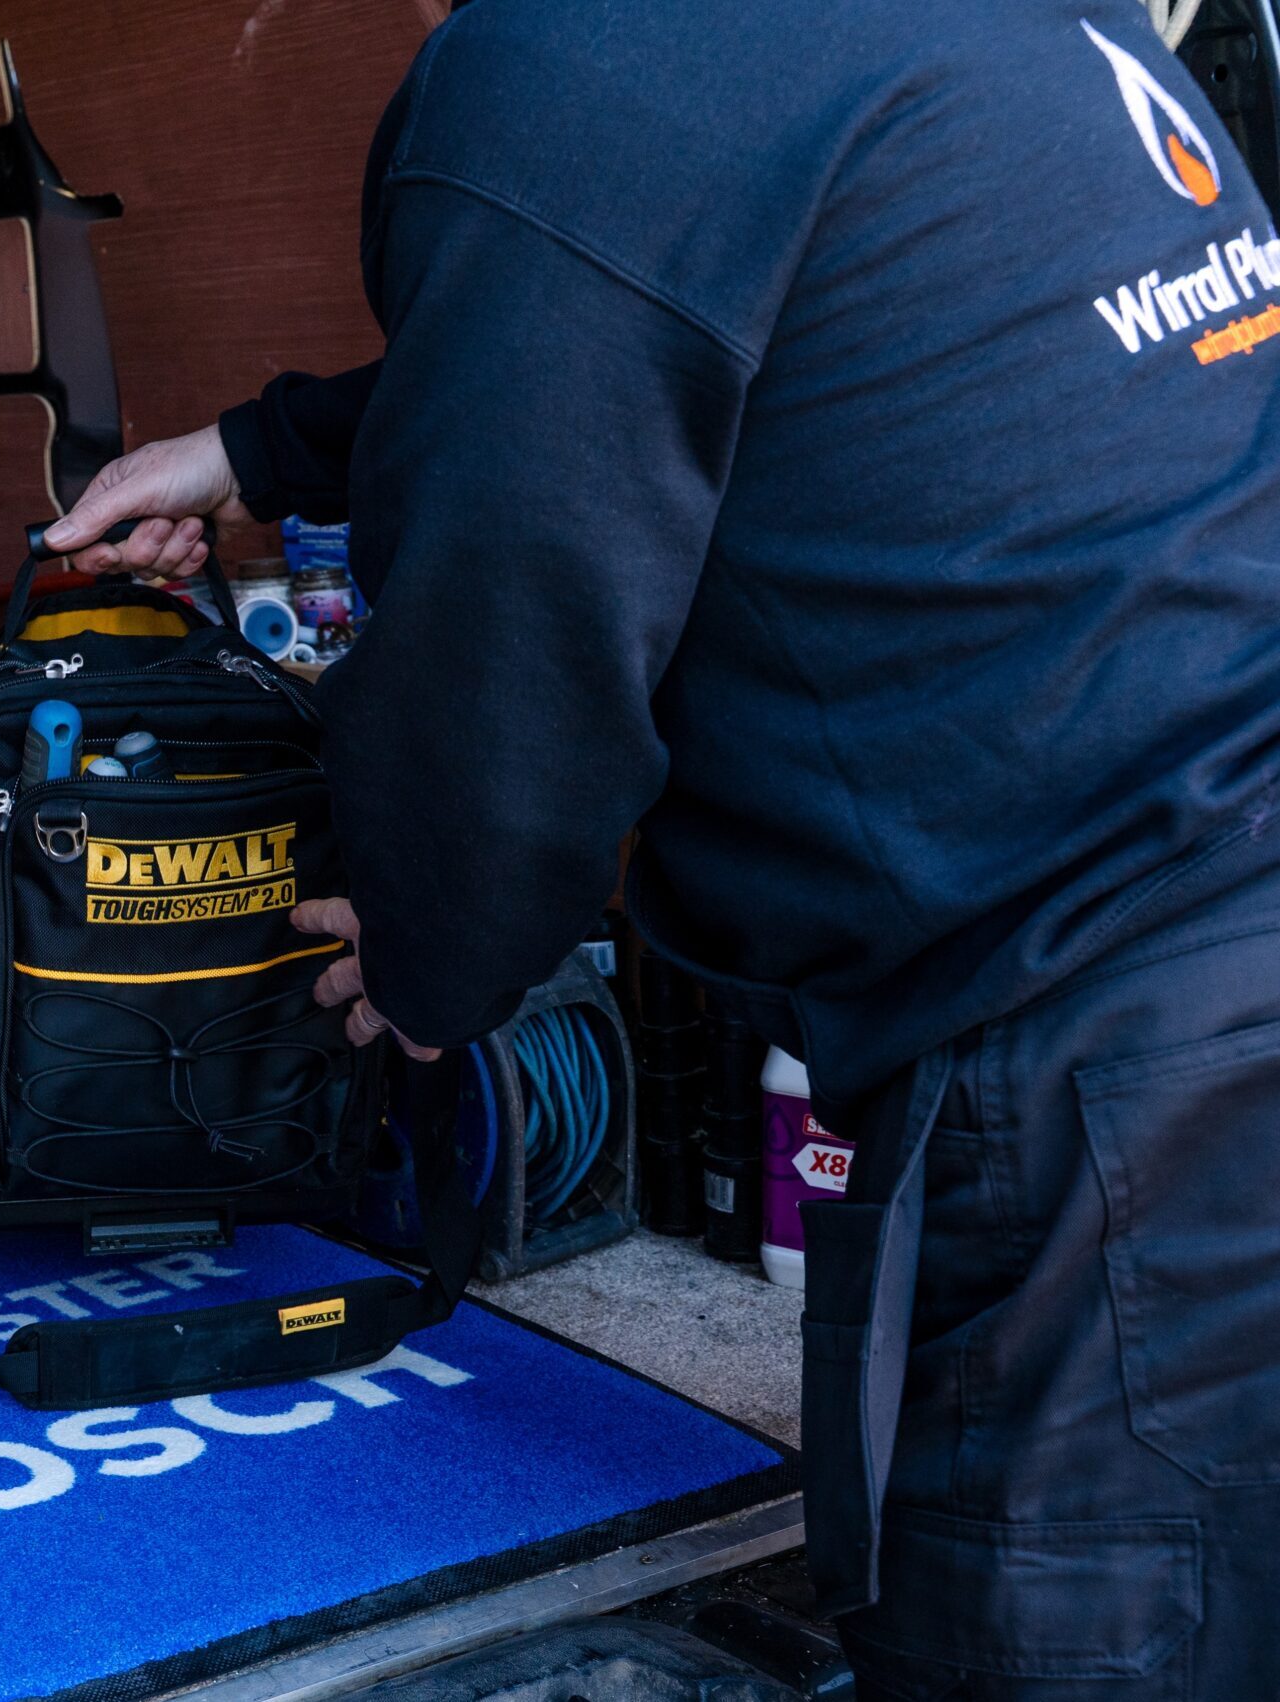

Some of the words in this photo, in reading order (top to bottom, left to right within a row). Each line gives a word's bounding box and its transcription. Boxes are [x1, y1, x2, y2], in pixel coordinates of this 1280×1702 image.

[1093, 241, 1240, 353] Wirral
[261, 882, 294, 908] 2.0
[808, 1149, 850, 1177] X8
